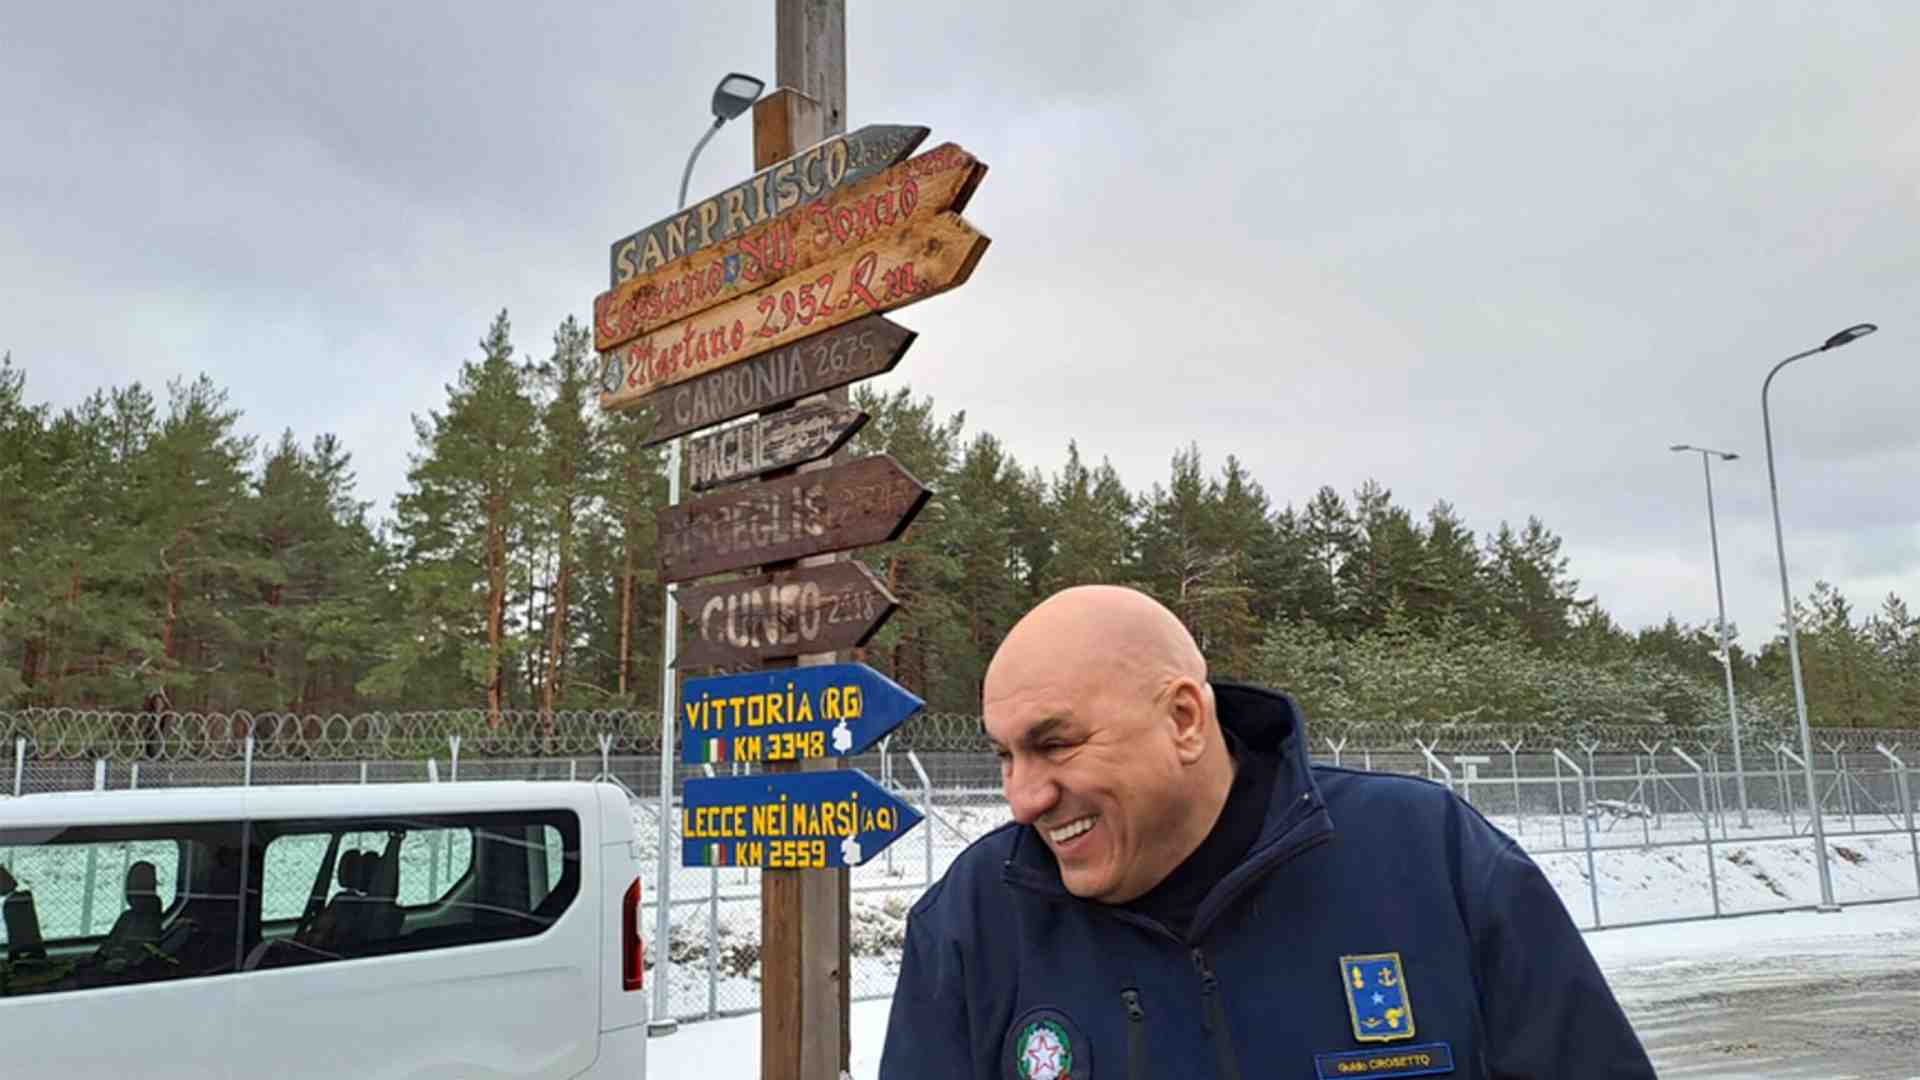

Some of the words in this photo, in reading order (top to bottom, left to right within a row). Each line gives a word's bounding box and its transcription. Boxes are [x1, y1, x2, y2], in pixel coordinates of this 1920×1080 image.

[626, 319, 745, 388] Martano
[753, 272, 834, 338] 2952
[673, 346, 808, 426] CARBONIA
[820, 685, 864, 721] (RG)
[733, 736, 763, 764] KM
[767, 731, 825, 761] 3348
[682, 805, 748, 838] LECCE
[735, 842, 763, 867] KM
[768, 840, 826, 868] 2559
